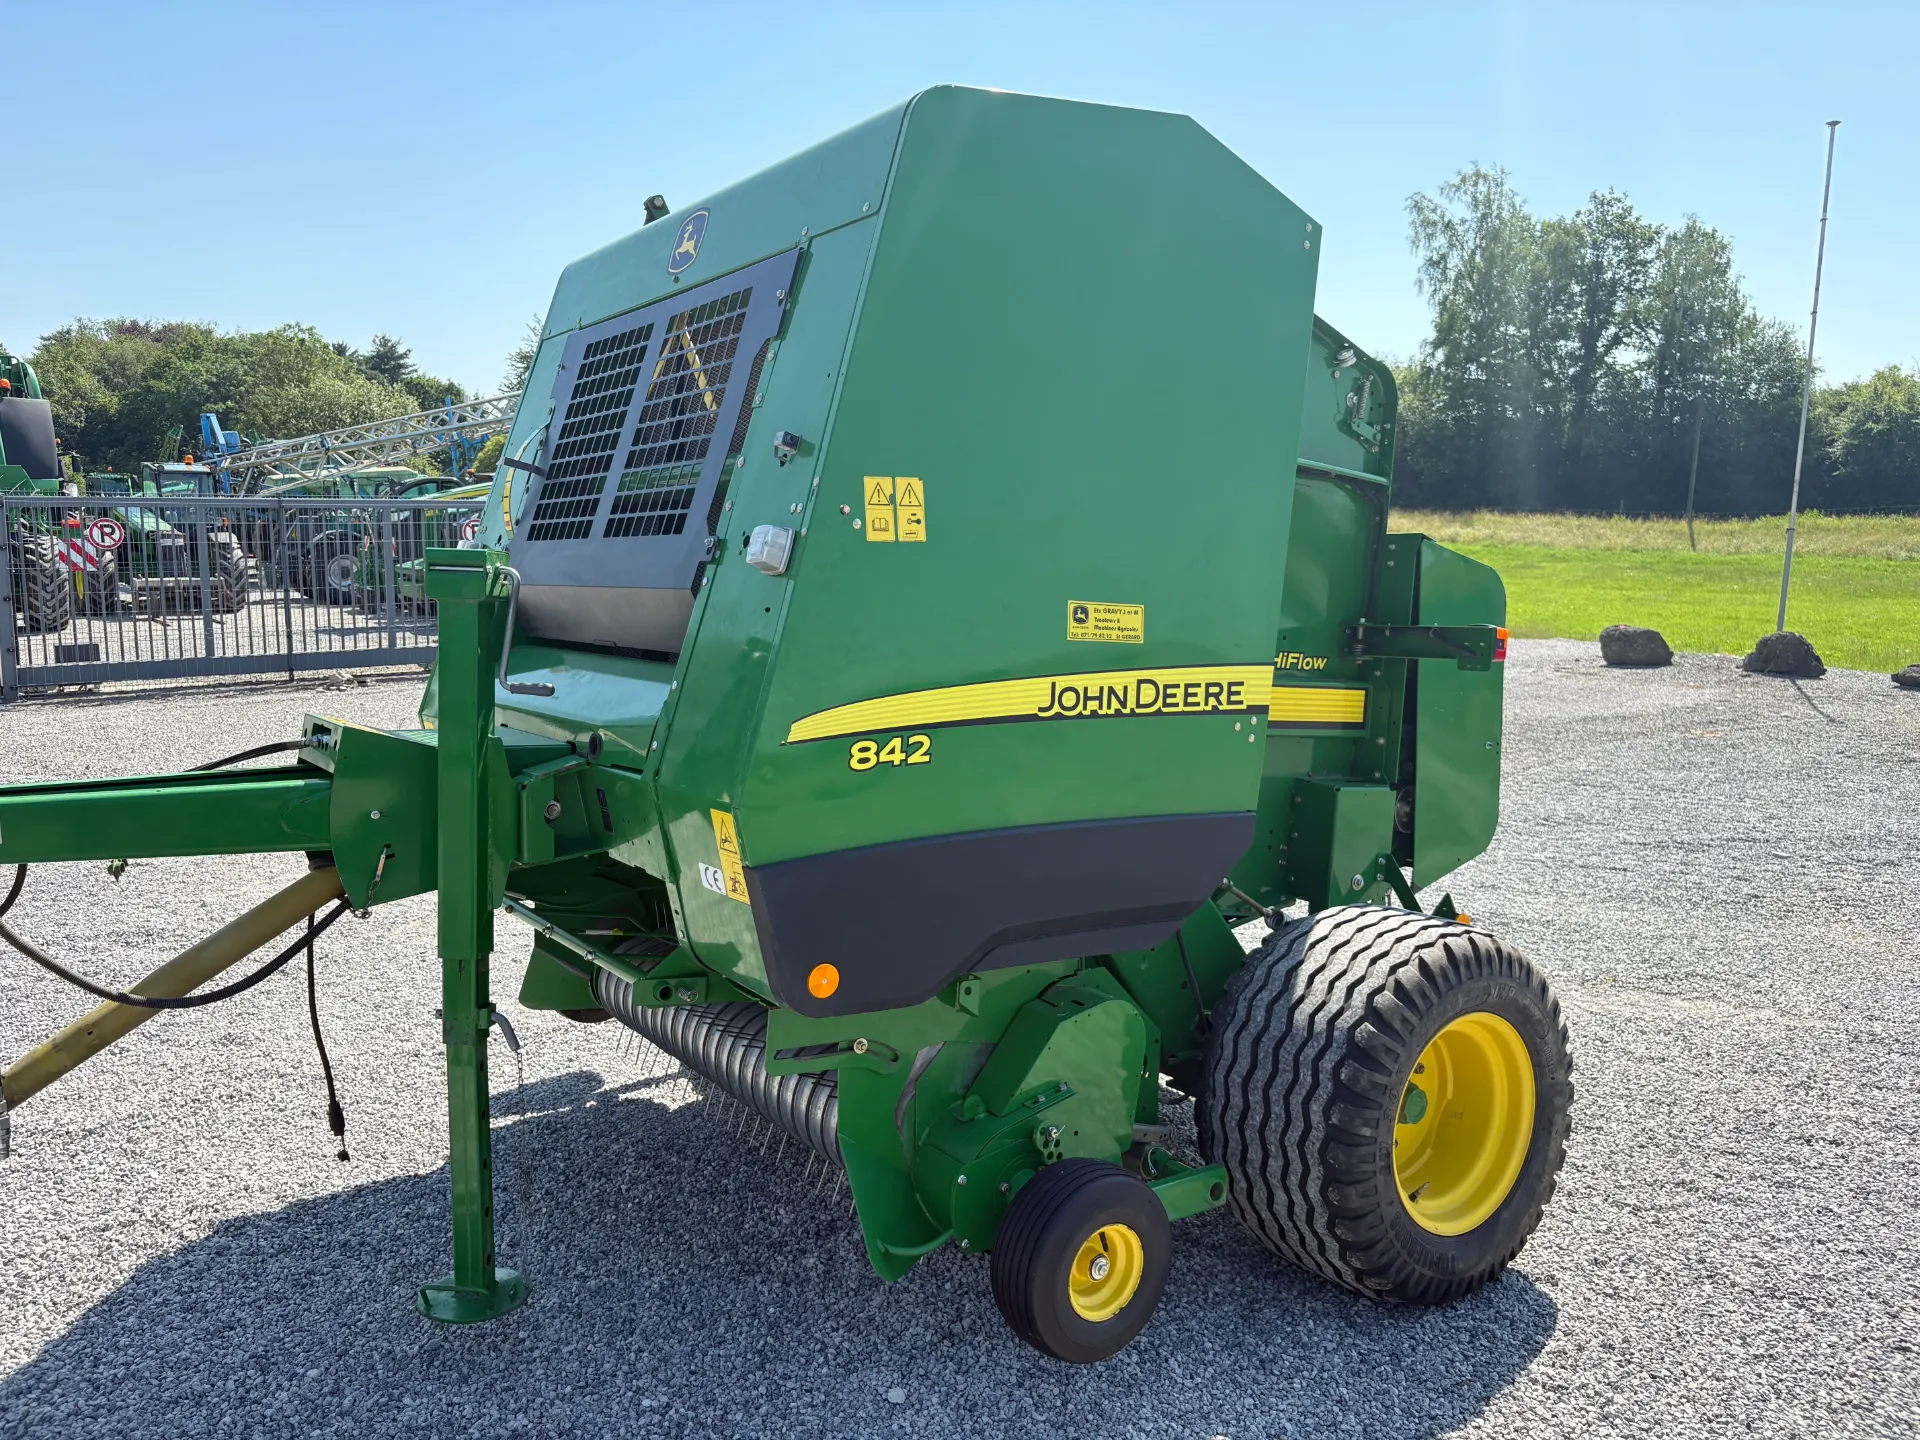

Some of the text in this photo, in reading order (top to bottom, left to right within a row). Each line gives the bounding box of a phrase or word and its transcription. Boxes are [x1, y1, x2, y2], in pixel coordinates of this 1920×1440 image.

[1273, 651, 1329, 671] HiFlow
[1038, 678, 1247, 716] JOHN DEERE
[848, 733, 933, 771] 842
[705, 866, 721, 891] CE
